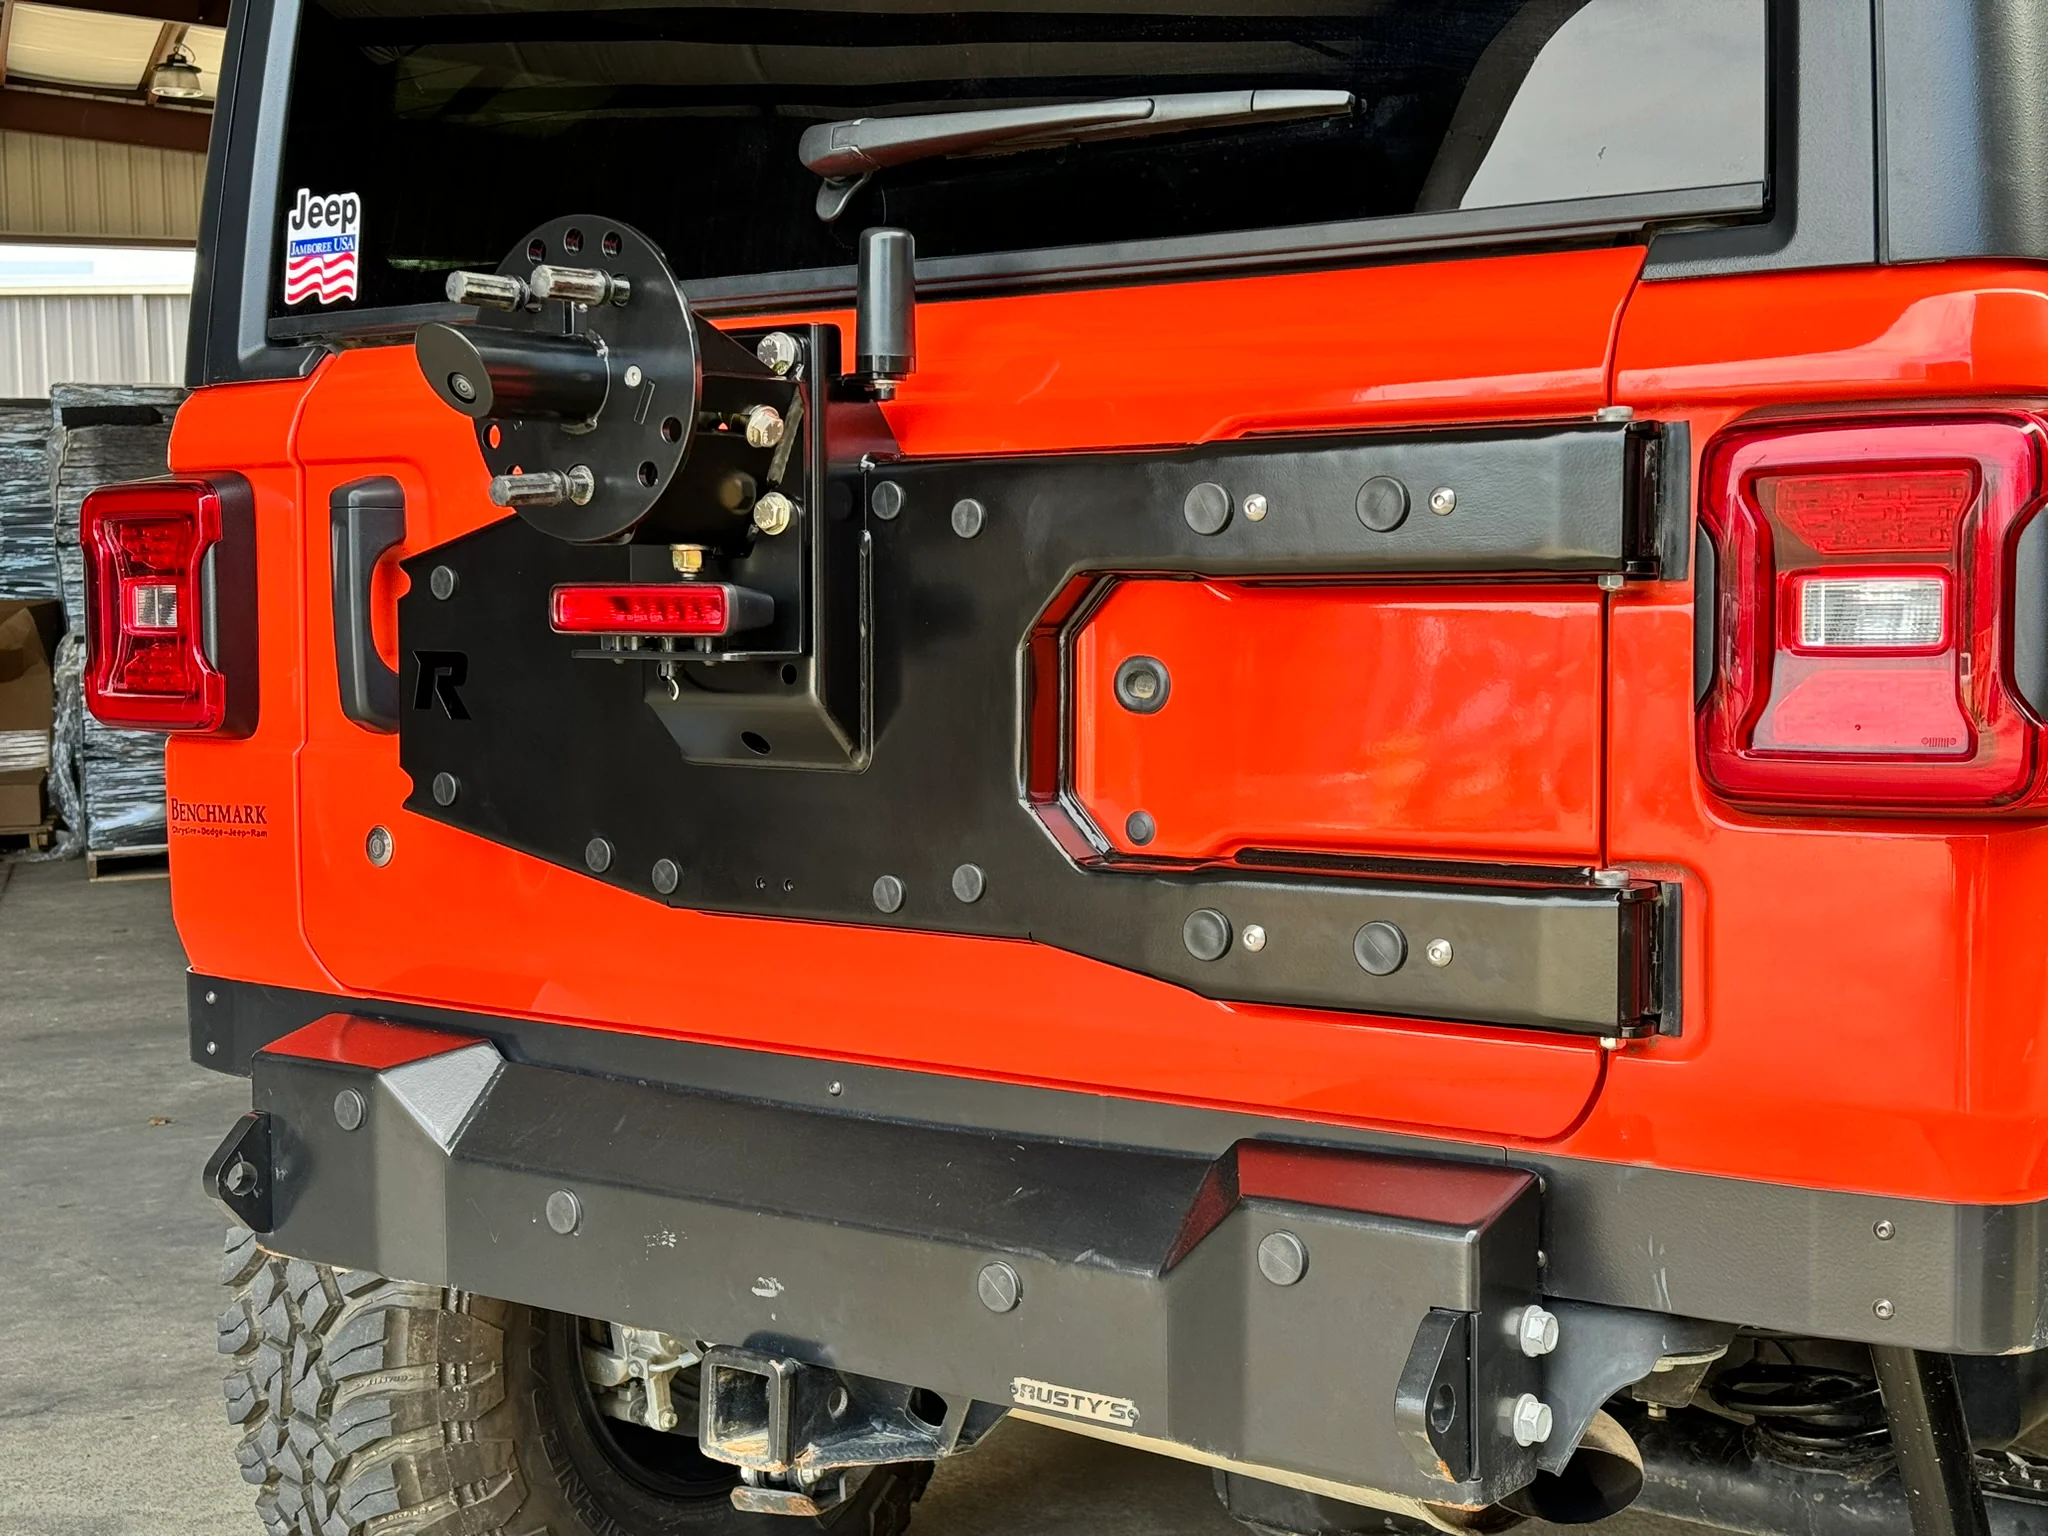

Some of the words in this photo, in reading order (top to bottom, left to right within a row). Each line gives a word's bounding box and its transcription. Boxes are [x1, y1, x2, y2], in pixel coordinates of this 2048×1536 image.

[291, 193, 357, 234] Jeep
[290, 241, 332, 256] JAMBOREE
[333, 237, 355, 252] USA
[412, 649, 472, 721] R
[170, 797, 268, 825] BENCHMARK
[1019, 1382, 1128, 1420] RUSTY'S
